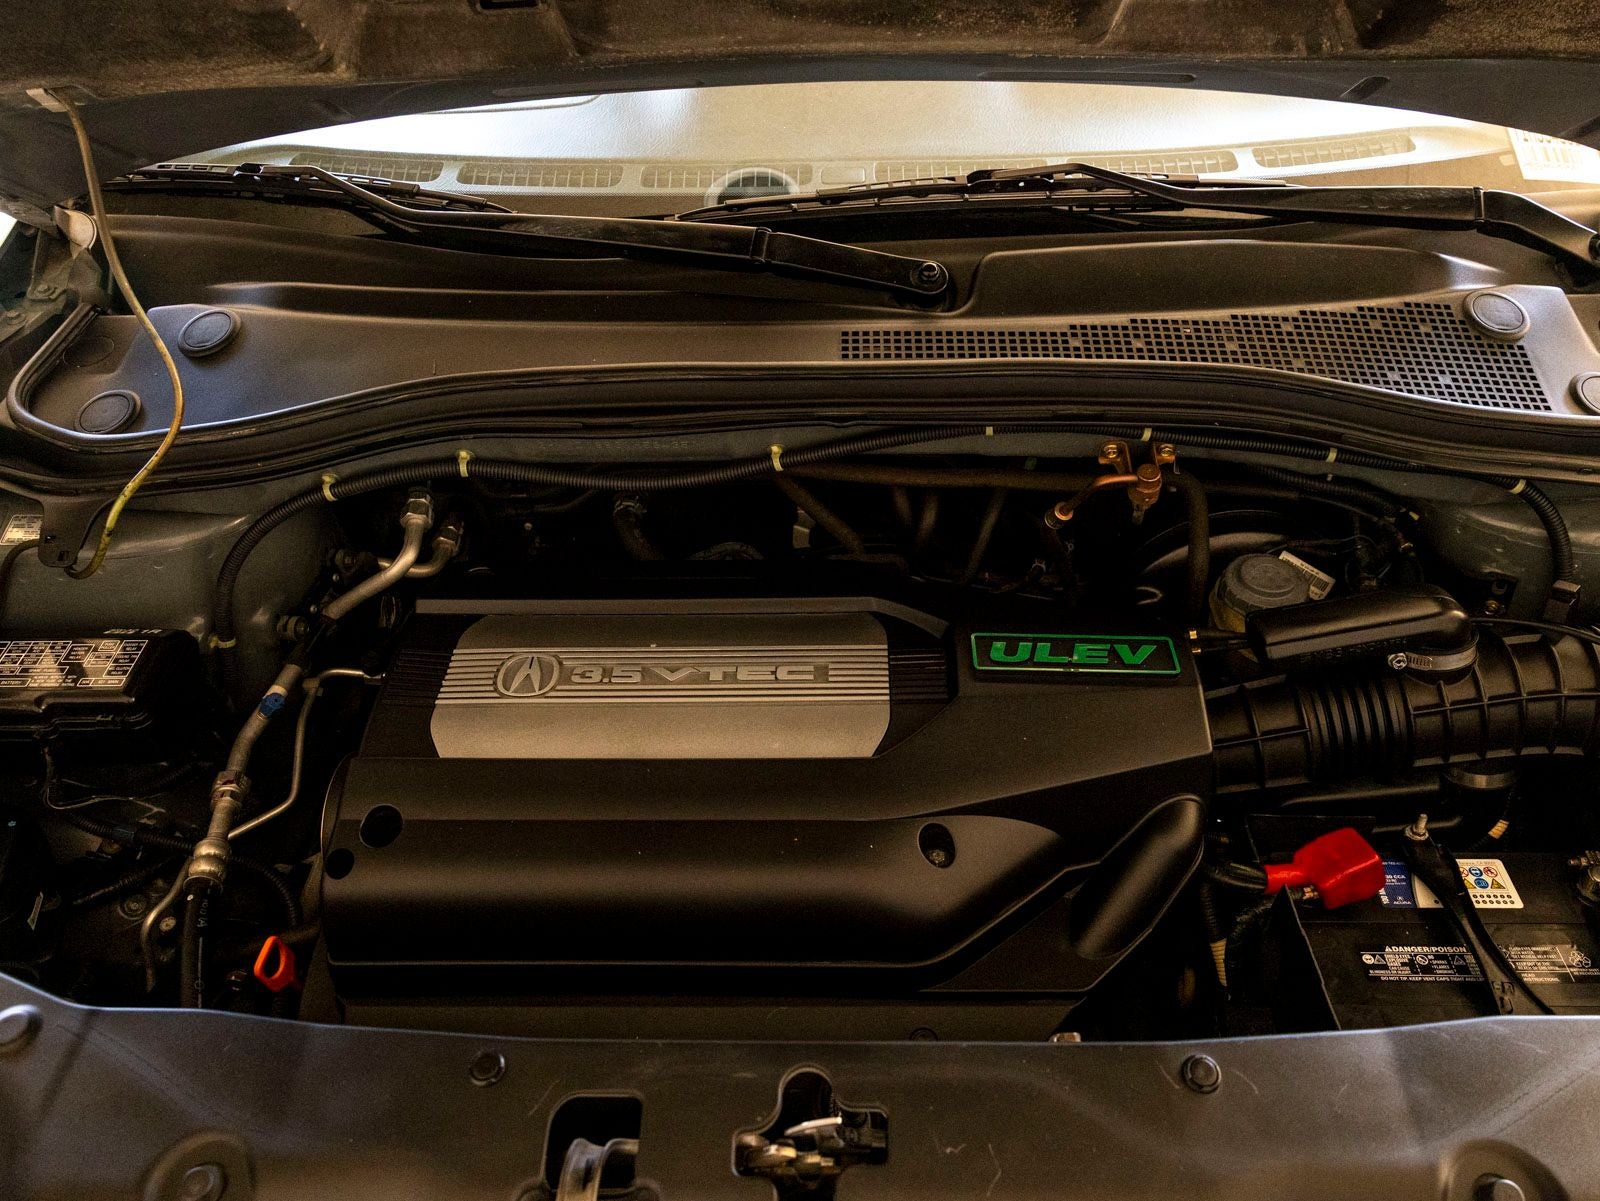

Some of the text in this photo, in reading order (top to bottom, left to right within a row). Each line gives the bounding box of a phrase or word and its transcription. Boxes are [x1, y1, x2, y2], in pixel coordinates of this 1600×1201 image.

[990, 641, 1157, 665] ULEV
[570, 665, 815, 683] 3.5 VTEC
